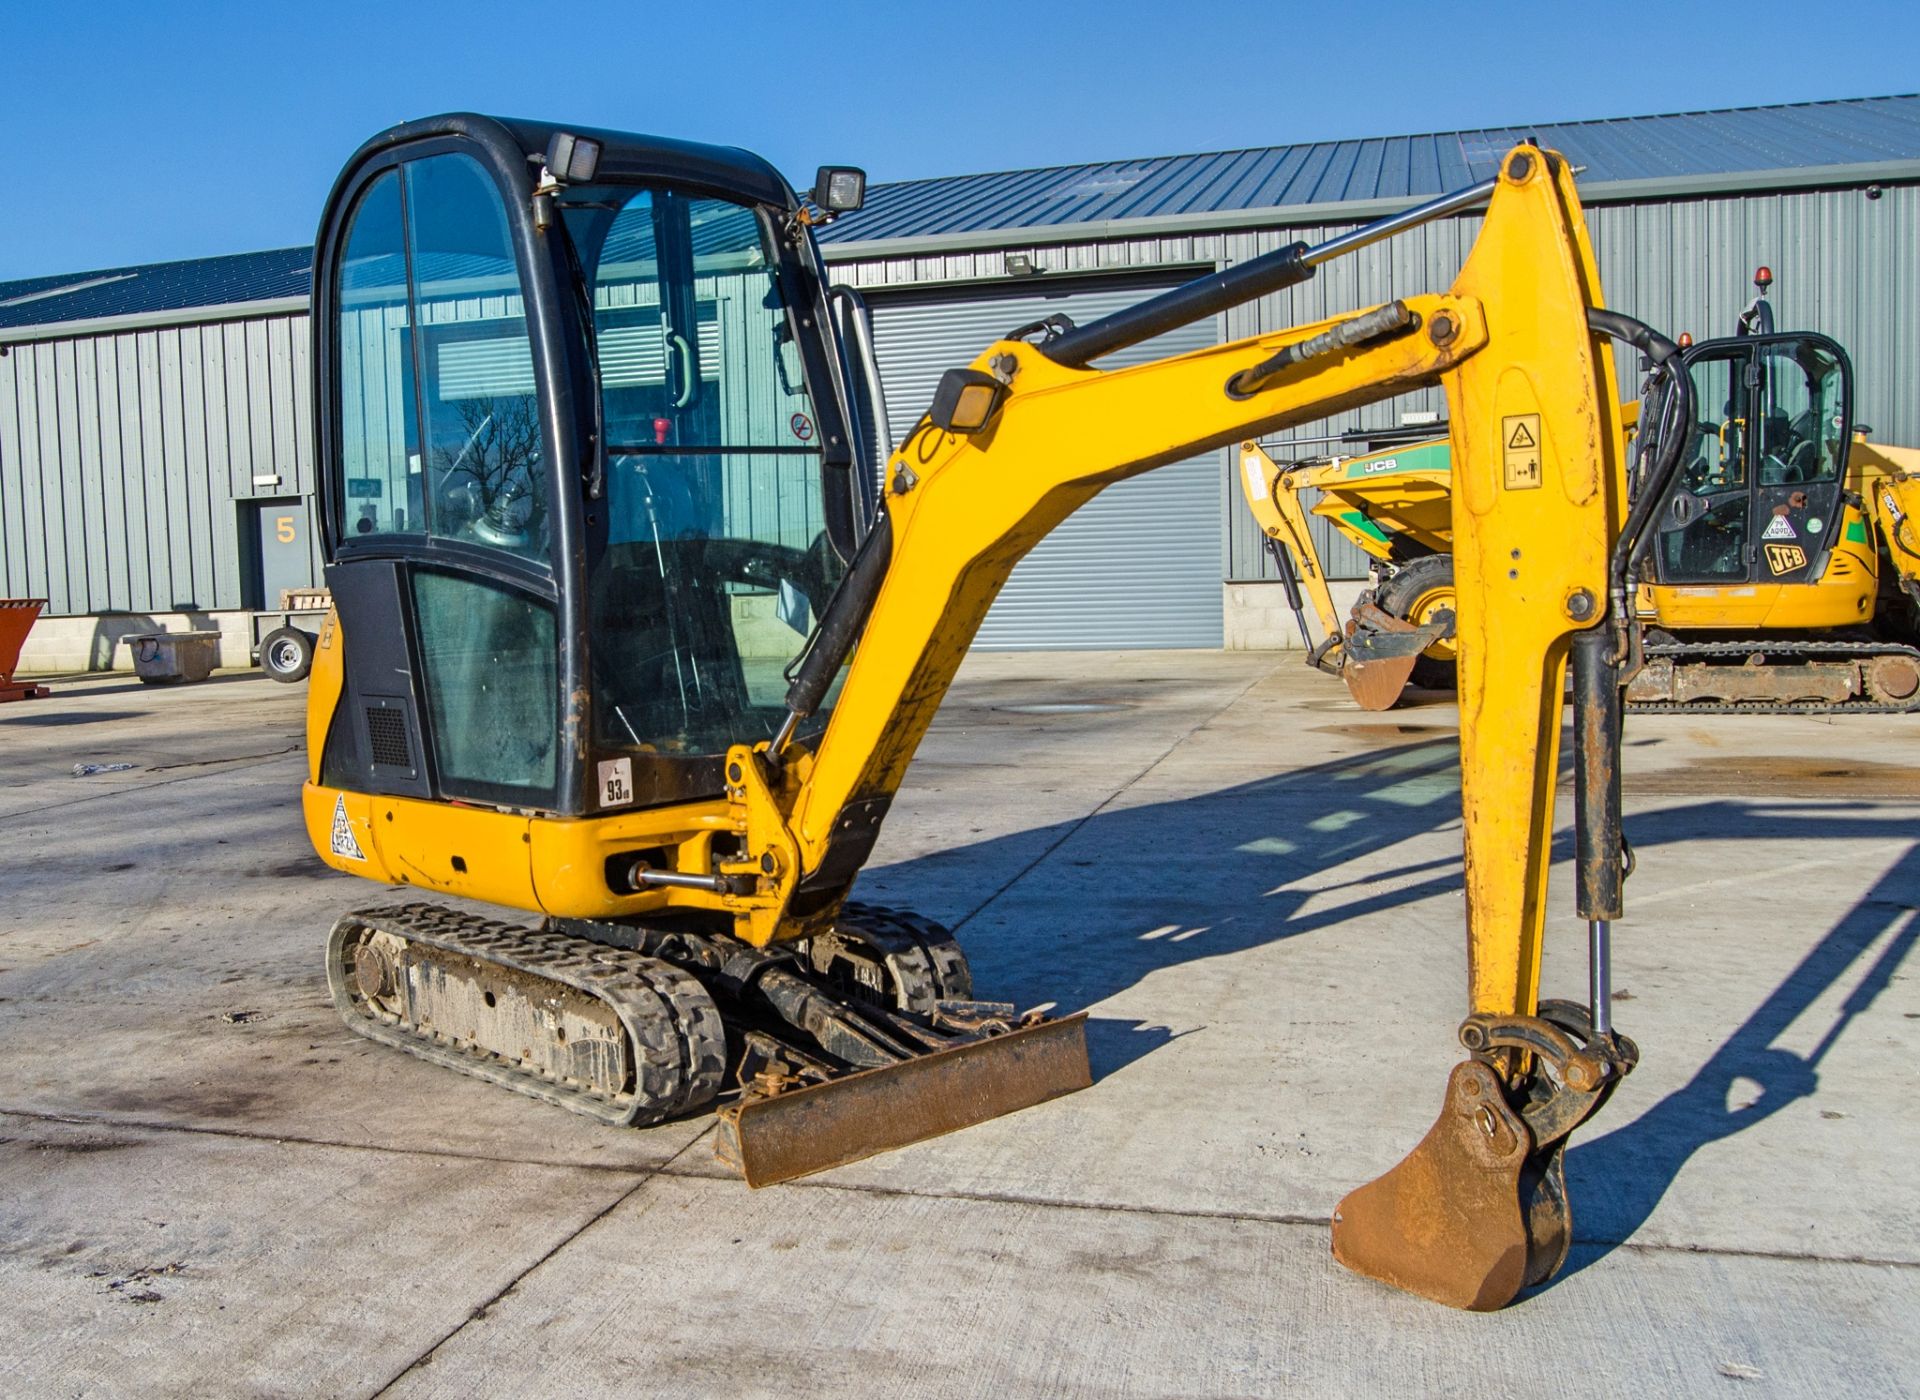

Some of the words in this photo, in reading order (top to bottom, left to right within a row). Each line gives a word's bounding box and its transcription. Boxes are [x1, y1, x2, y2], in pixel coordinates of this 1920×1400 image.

[1364, 459, 1397, 473] JCB
[277, 516, 296, 544] 5
[1770, 547, 1803, 572] JCB
[607, 779, 623, 802] 93
